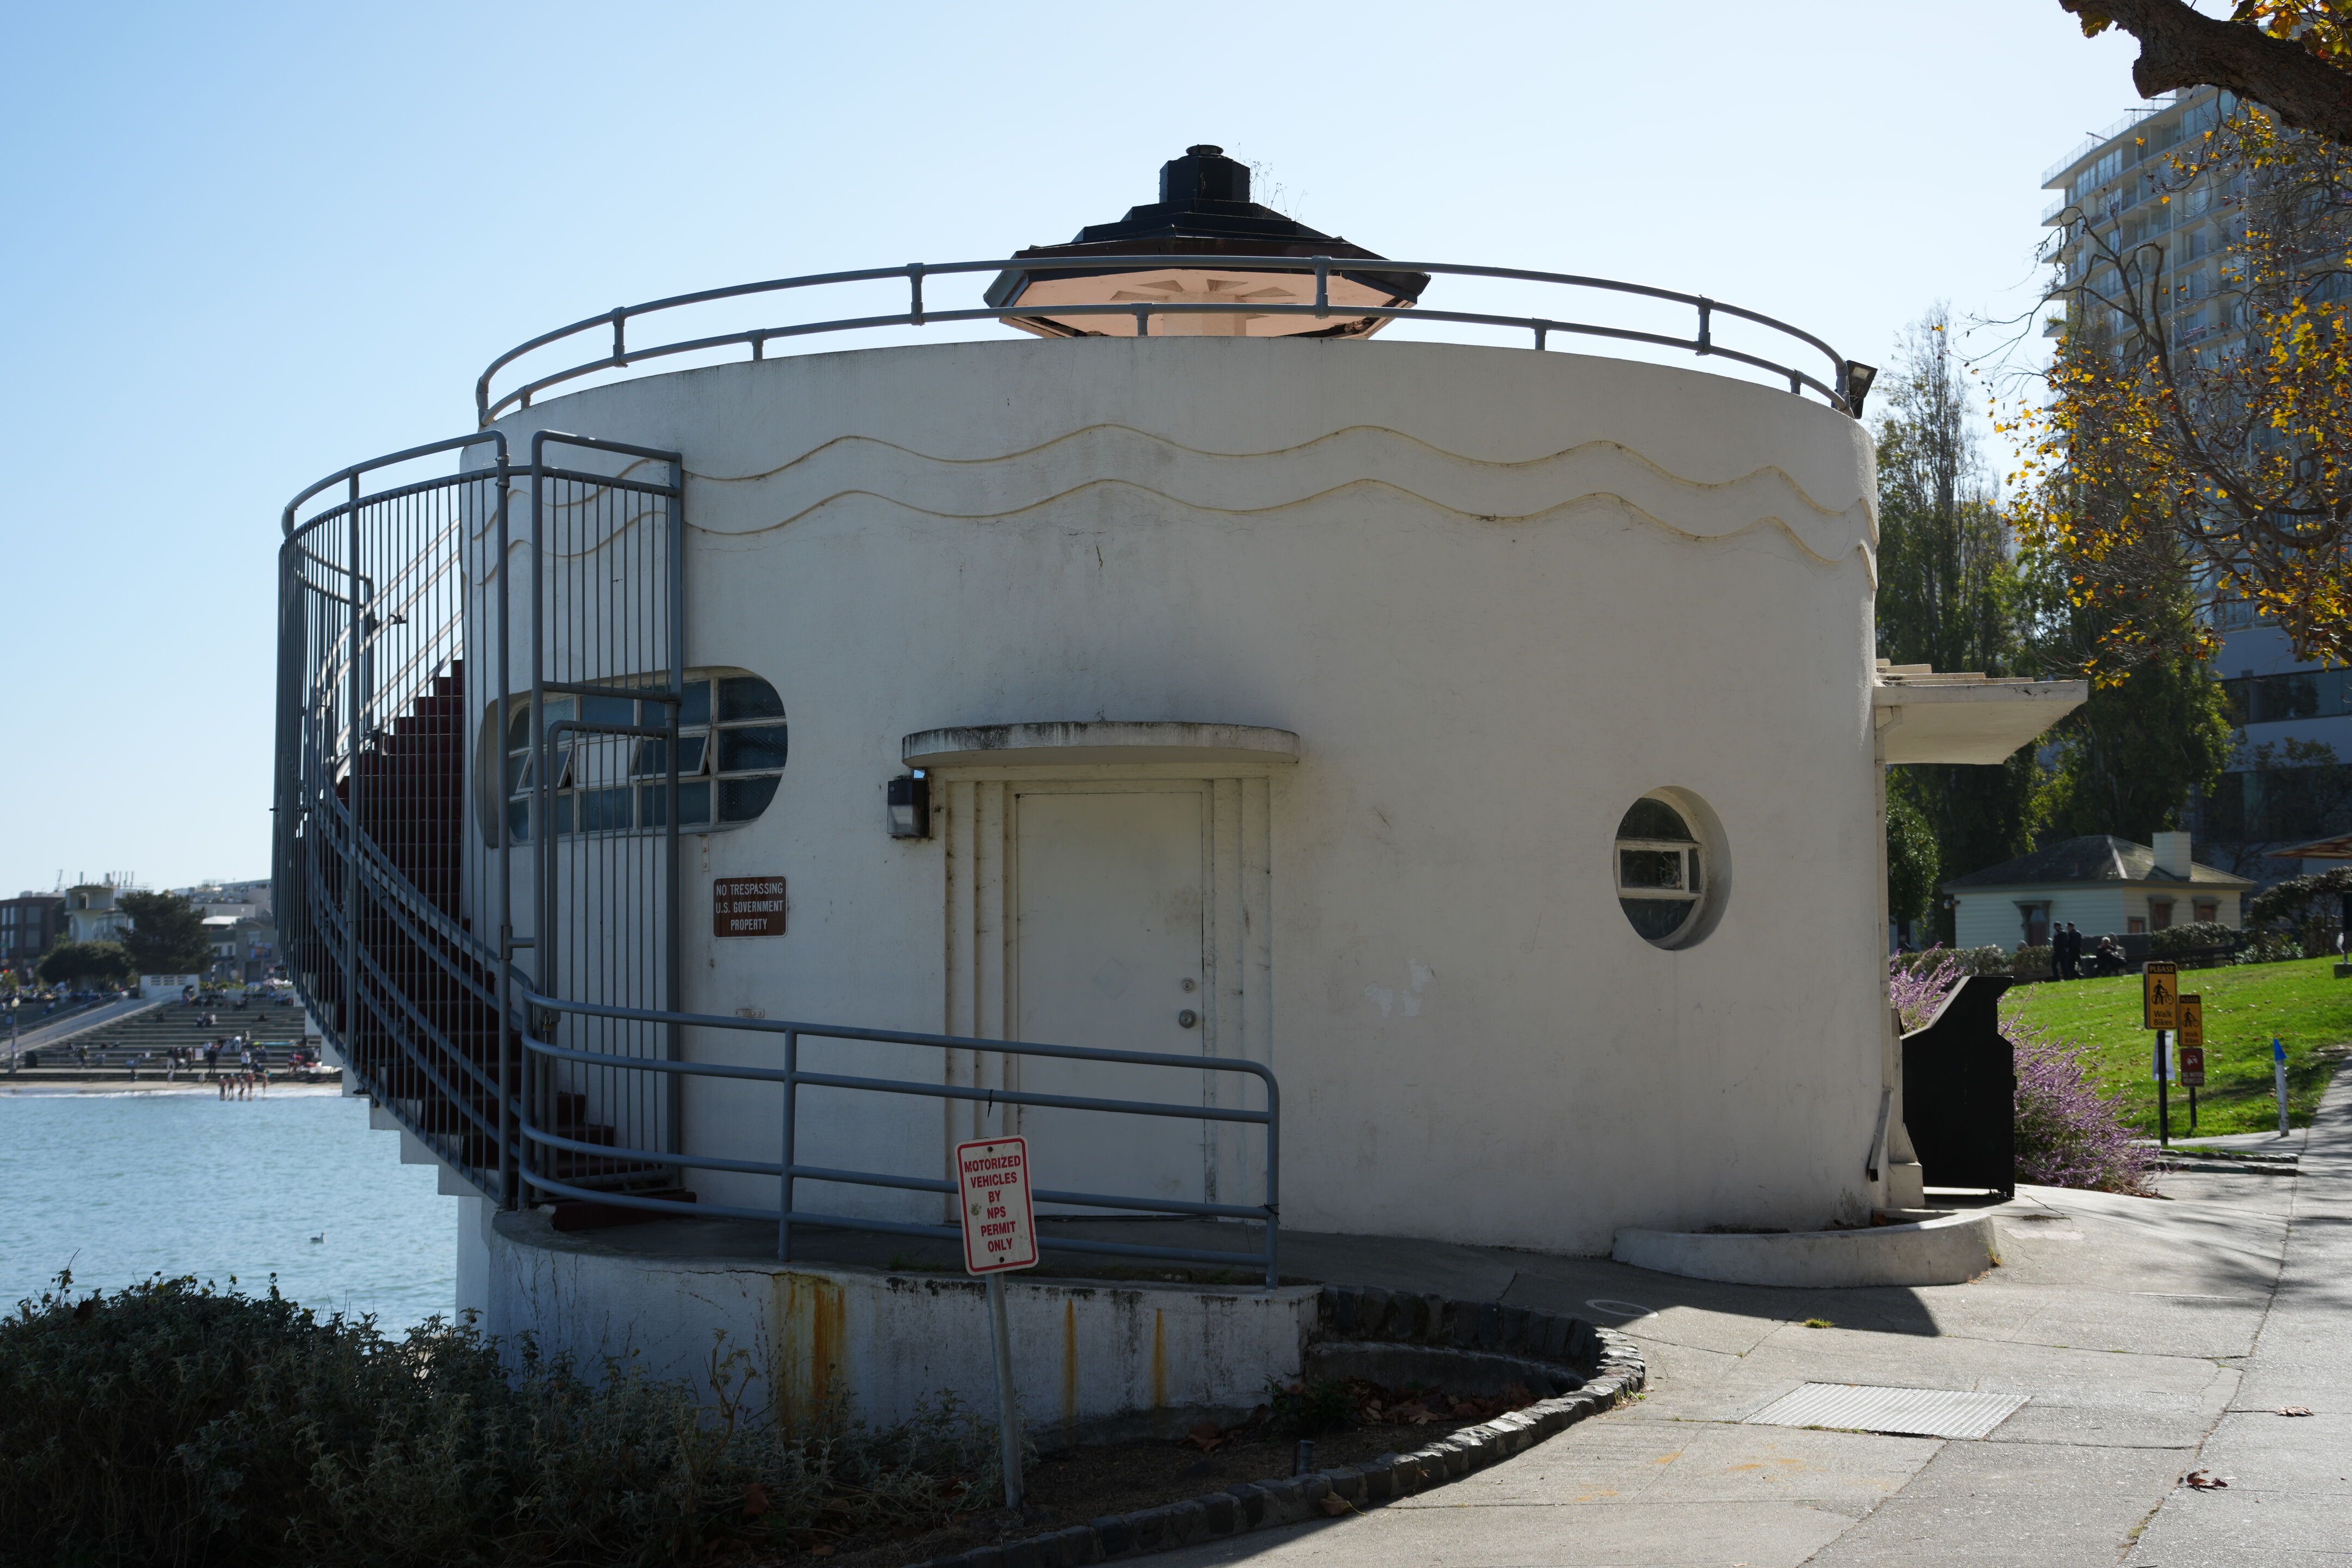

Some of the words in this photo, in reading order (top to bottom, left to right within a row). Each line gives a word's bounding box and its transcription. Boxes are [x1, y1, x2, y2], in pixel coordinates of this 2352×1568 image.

[716, 885, 727, 896] NO
[730, 883, 783, 895] TRESPASSING
[715, 902, 730, 914] U.S.
[733, 901, 783, 913] GOVERNMENT
[731, 918, 767, 930] PROPERTY
[964, 1155, 1021, 1173] MOTORIZED
[970, 1172, 1017, 1189] VEHICLES
[988, 1190, 1001, 1203] BY
[987, 1206, 1006, 1219] NPS
[981, 1221, 1016, 1237] PERMIT
[988, 1238, 1013, 1252] ONLY
